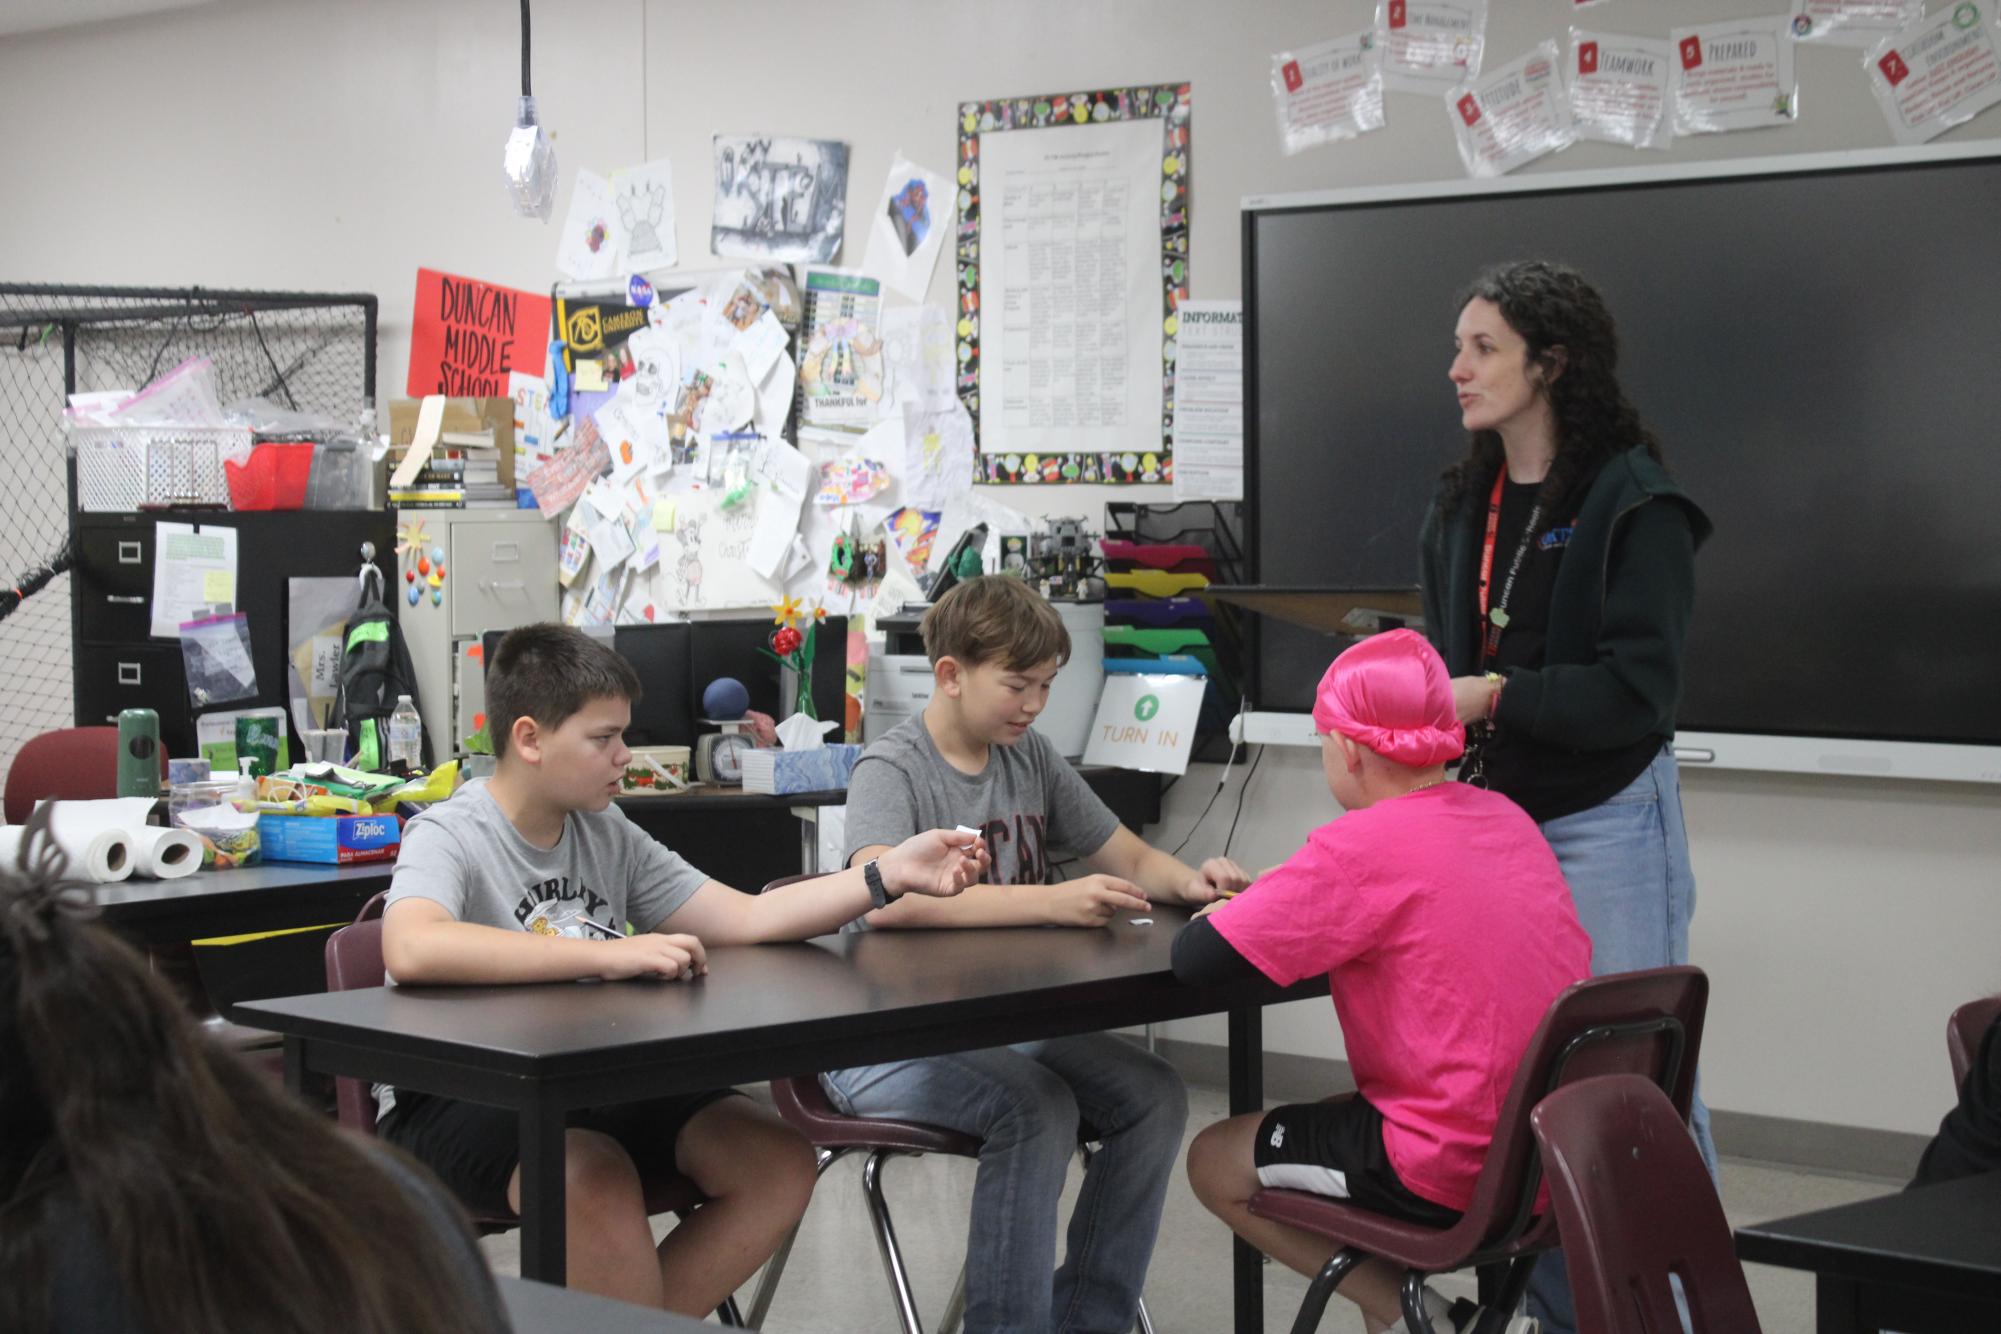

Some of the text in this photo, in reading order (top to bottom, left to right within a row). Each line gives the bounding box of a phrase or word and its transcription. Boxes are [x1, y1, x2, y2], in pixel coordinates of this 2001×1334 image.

[1600, 51, 1655, 77] TEAMWORK
[1708, 41, 1757, 61] PREPARED
[441, 276, 517, 337] DUNCAN
[602, 308, 643, 327] CAMERON
[444, 325, 515, 374] MIDDLE
[1500, 576, 1515, 608] uncan
[316, 650, 326, 681] Mrs.
[1103, 725, 1178, 747] TURN IN
[355, 822, 385, 841] Ziploc
